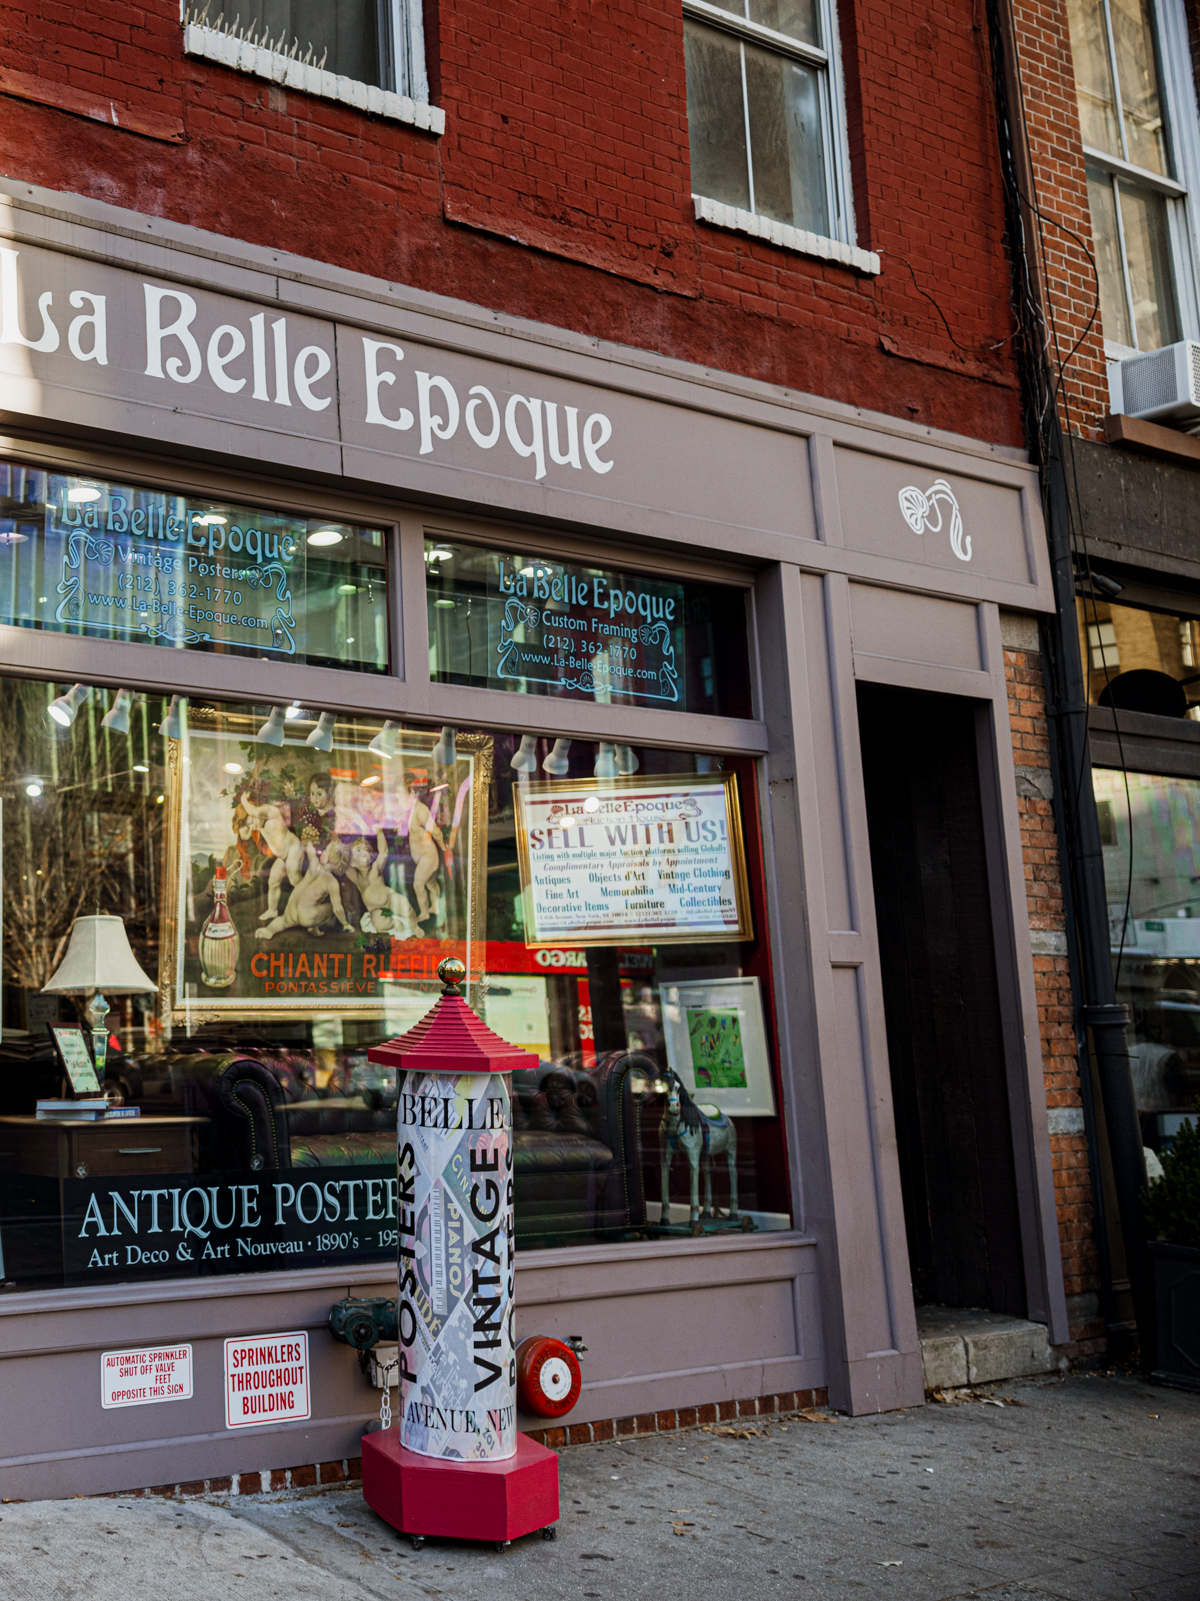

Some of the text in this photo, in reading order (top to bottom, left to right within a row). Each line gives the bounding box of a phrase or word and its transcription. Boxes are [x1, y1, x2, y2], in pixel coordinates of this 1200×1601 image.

[0, 247, 614, 479] La Belle Epoque
[60, 486, 295, 562] La Belle Epoque
[117, 545, 245, 581] Vintage Posters
[118, 573, 242, 605] (212) 362-1770
[499, 561, 675, 623] La Belle Epoque
[87, 593, 269, 630] www.La-Belle-Epoque.com
[542, 610, 638, 643] Custom Framing
[543, 634, 637, 660] (212) 362-1770
[521, 650, 657, 680] www.La-Belle-Epoque.com
[586, 801, 622, 815] elle
[623, 800, 683, 814] Epoque
[530, 819, 727, 851] SELL WITH US!
[533, 844, 726, 861] Listing with multiple major Auction platforms selling Globally
[543, 856, 718, 872] Complimentary Appraisals by Appointment
[534, 867, 731, 886] Antiques Objects d'Art Vintage Clothing
[545, 883, 722, 900] Fine Art Memorabilia Mid-Century
[536, 897, 732, 913] Decorative Items Furniture Collectibles
[250, 952, 455, 978] CHIANTI RUFFIN
[265, 981, 375, 993] PONTASSIEVE
[402, 1093, 503, 1129] BELLE
[78, 1178, 398, 1239] ANTIQUE POSTER
[87, 1229, 398, 1268] Art Deco & Art Nouveau 1890's 195
[448, 1203, 463, 1299] PIANOS
[470, 1147, 502, 1394] VINTAGE
[106, 1350, 188, 1368] AUTOMATIC SPRINKLER
[232, 1343, 301, 1368] SPRINKLERS
[119, 1362, 175, 1378] SHUT OFF VALVE
[155, 1373, 171, 1385] FEET
[230, 1366, 304, 1392] THROUGHOUT
[111, 1384, 184, 1401] OPPOSITE THIS SIGN
[242, 1390, 295, 1415] BUILDING
[407, 1401, 480, 1436] AVENUE,
[487, 1404, 515, 1433] NEW
